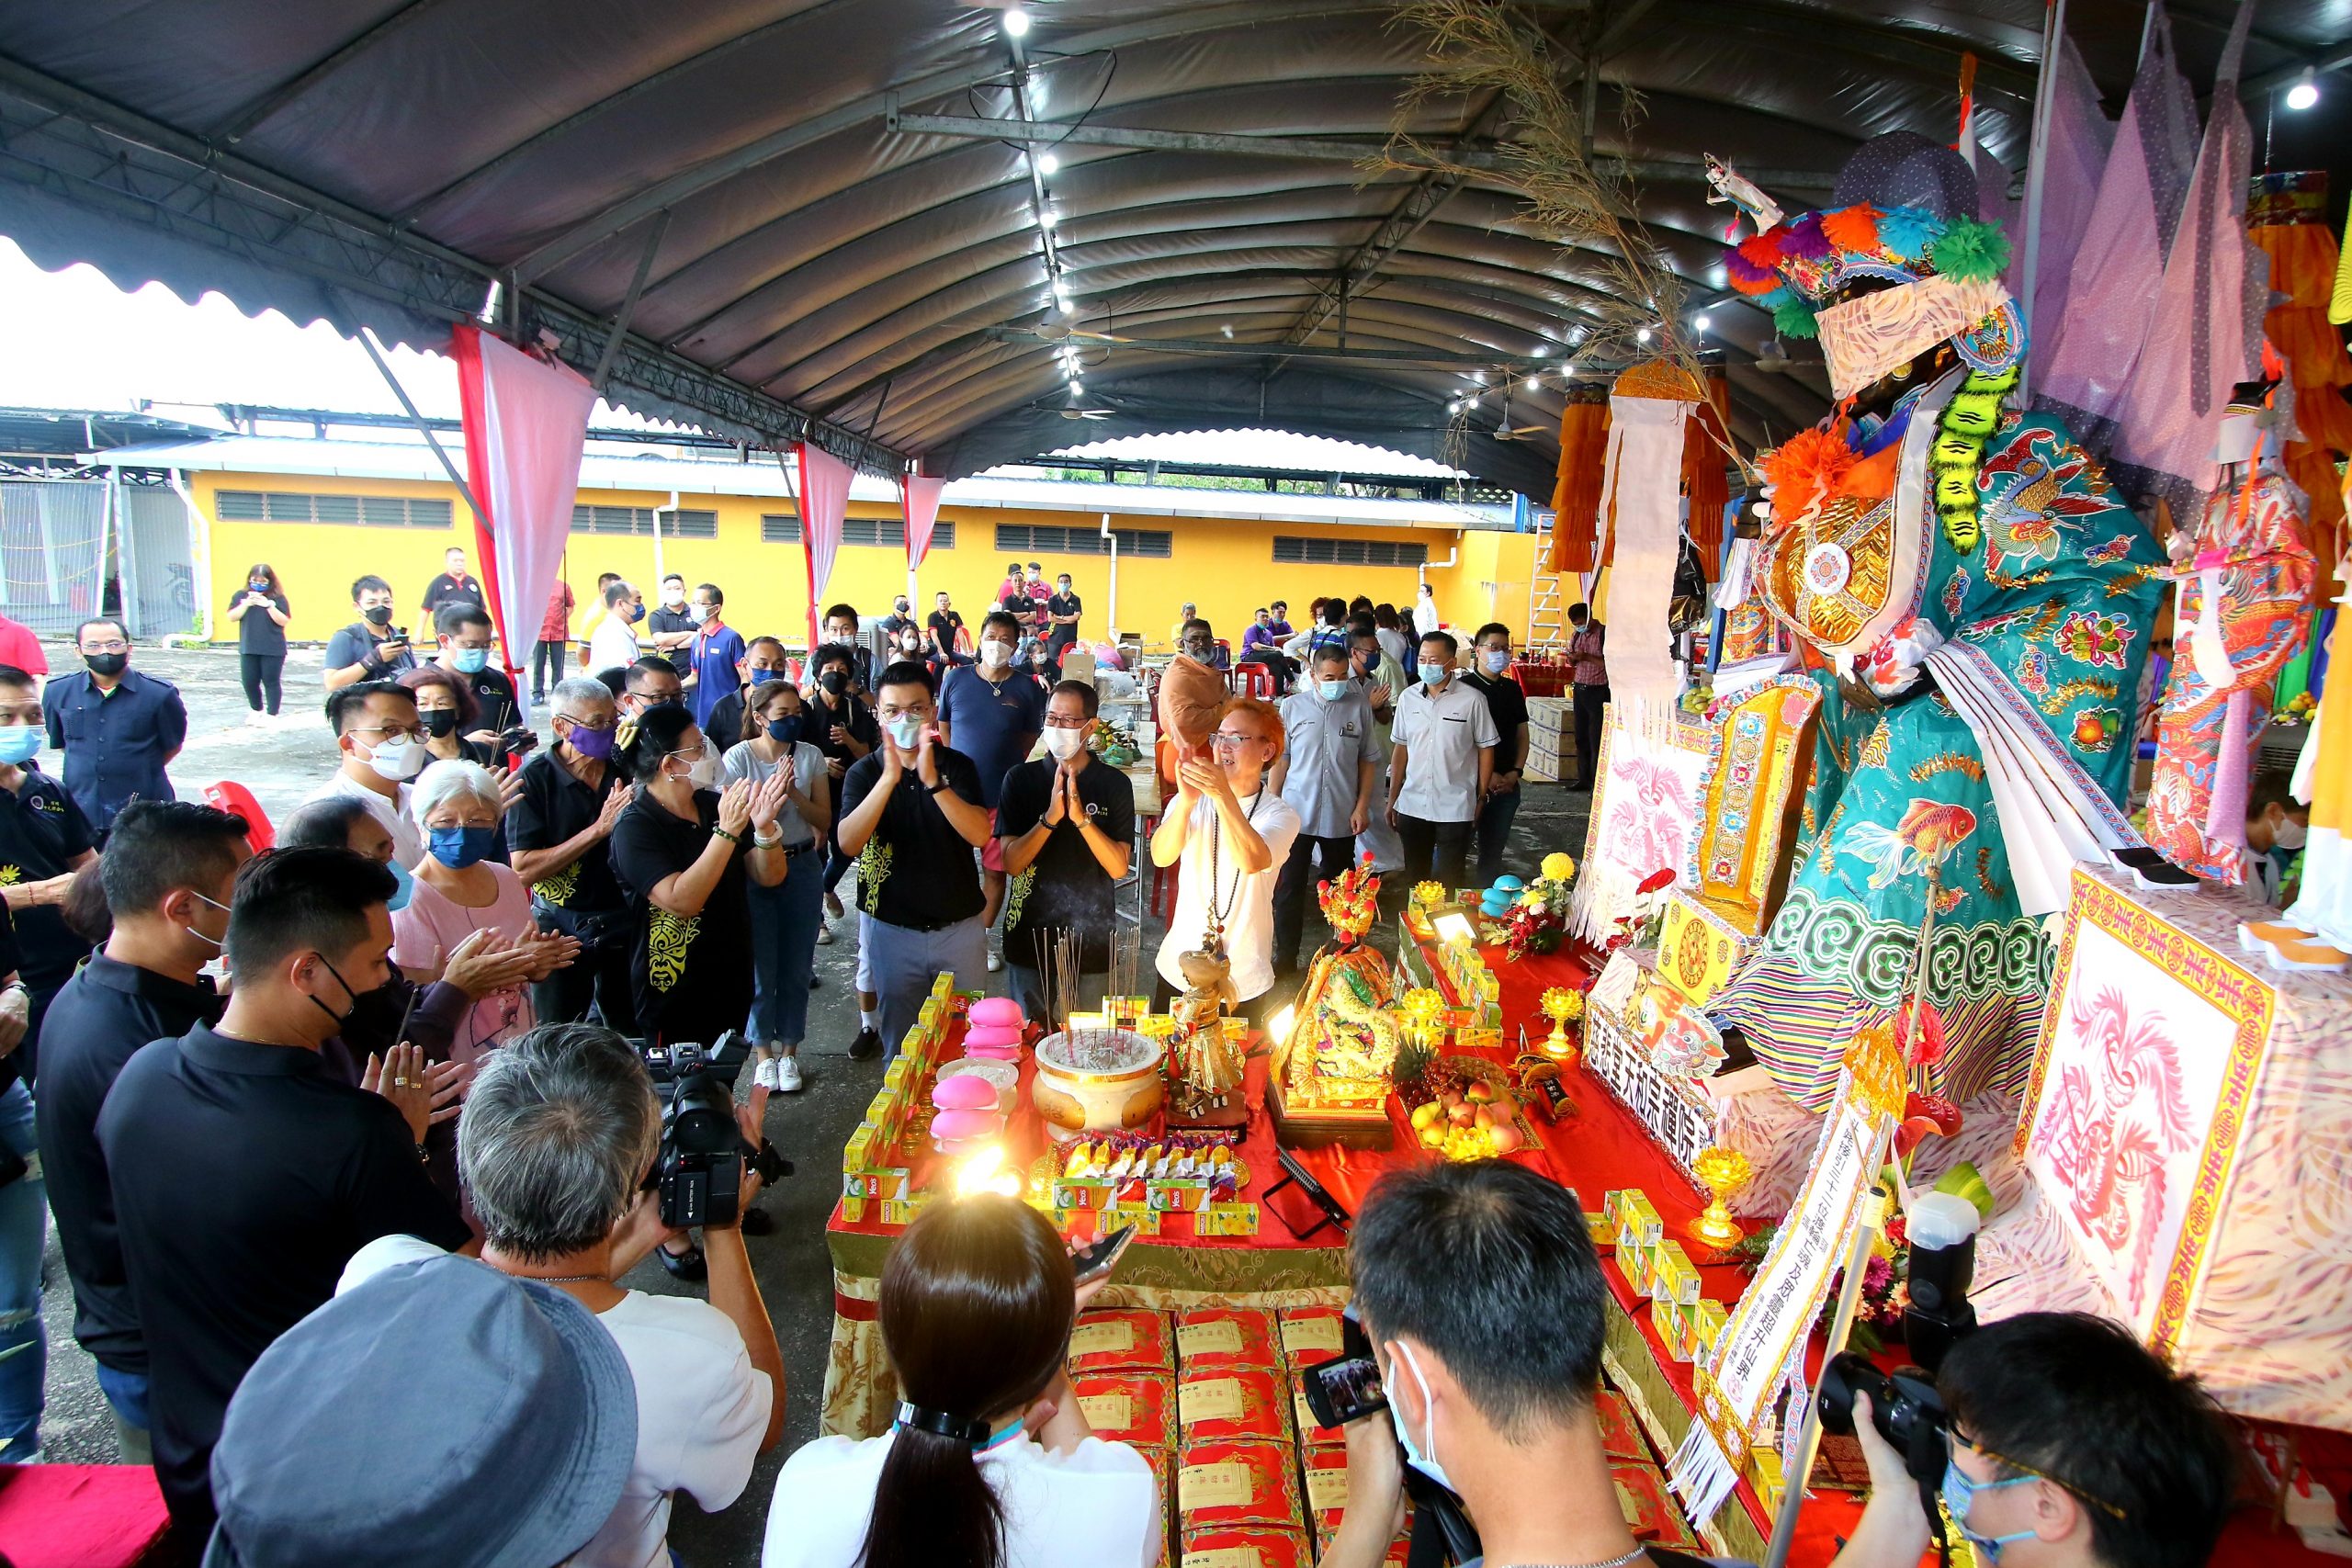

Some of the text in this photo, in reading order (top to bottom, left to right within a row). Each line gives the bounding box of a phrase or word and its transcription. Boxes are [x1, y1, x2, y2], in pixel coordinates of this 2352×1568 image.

[868, 1177, 877, 1195] Yeo's
[1079, 1189, 1087, 1206] Yeo's
[1171, 1190, 1181, 1208] Yeo's
